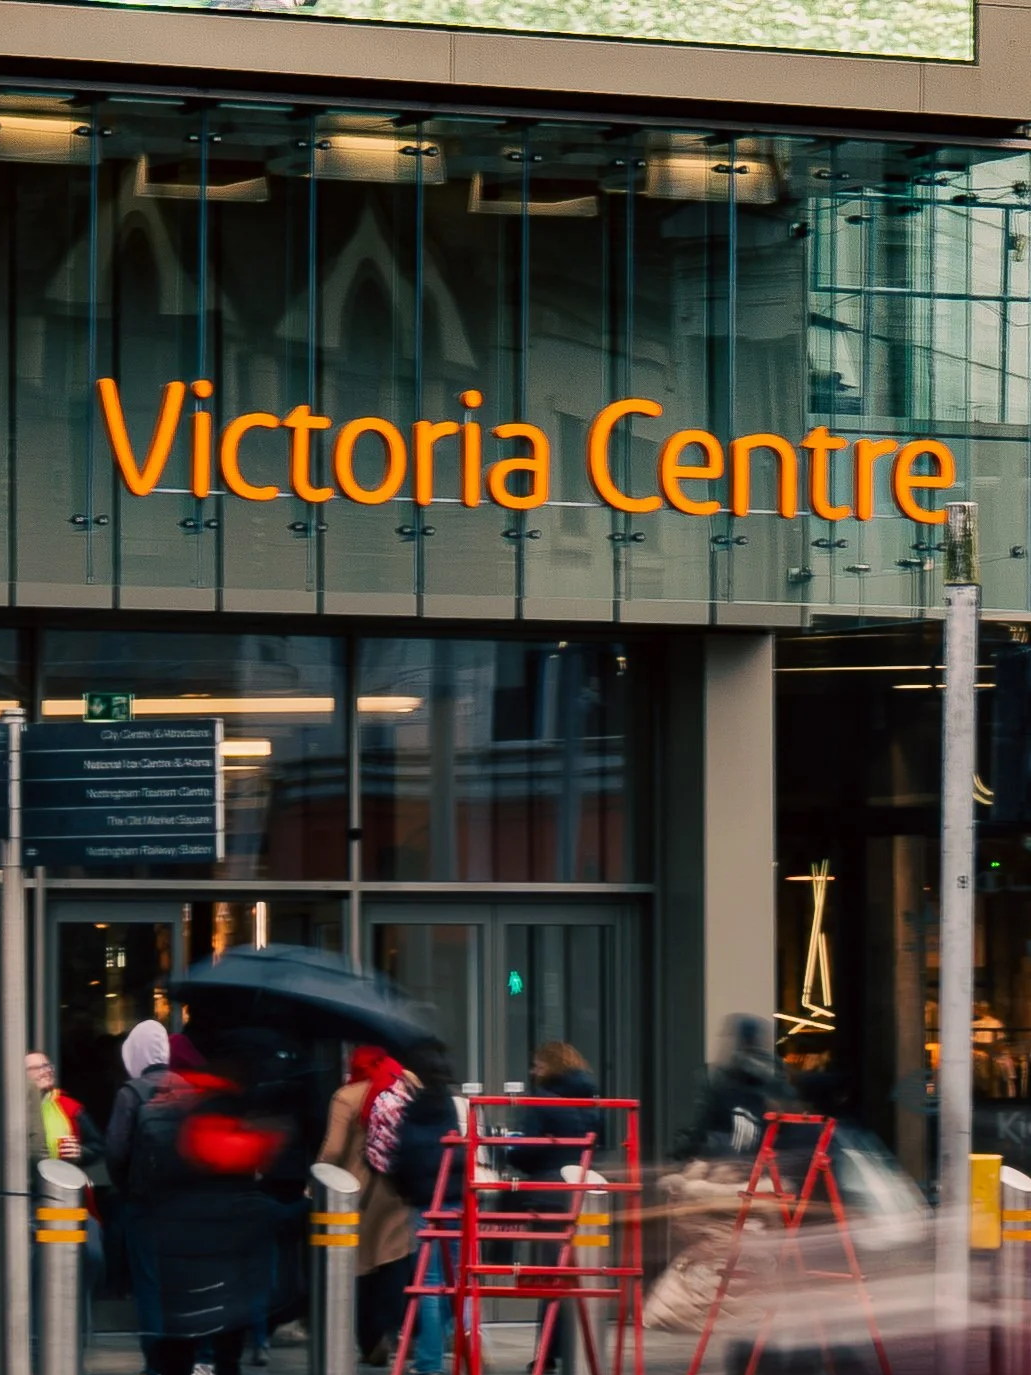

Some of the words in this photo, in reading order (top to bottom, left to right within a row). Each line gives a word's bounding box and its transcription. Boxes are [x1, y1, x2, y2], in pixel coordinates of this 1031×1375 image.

[96, 376, 551, 511] Victoria
[588, 397, 958, 526] Centre
[99, 729, 118, 742] City
[120, 729, 151, 740] Centre
[164, 728, 210, 738] Attractions
[83, 760, 121, 770] National
[139, 758, 171, 769] Centre
[183, 758, 212, 768] Arena
[85, 788, 139, 800] Nottingham
[141, 787, 176, 798] Tourism
[178, 786, 212, 797] Centre
[106, 816, 125, 826] The
[126, 815, 145, 826] Old
[146, 815, 175, 825] Market
[177, 814, 212, 828] Square
[85, 846, 139, 859] Nottingham
[140, 845, 178, 858] Railway
[179, 843, 213, 855] Station
